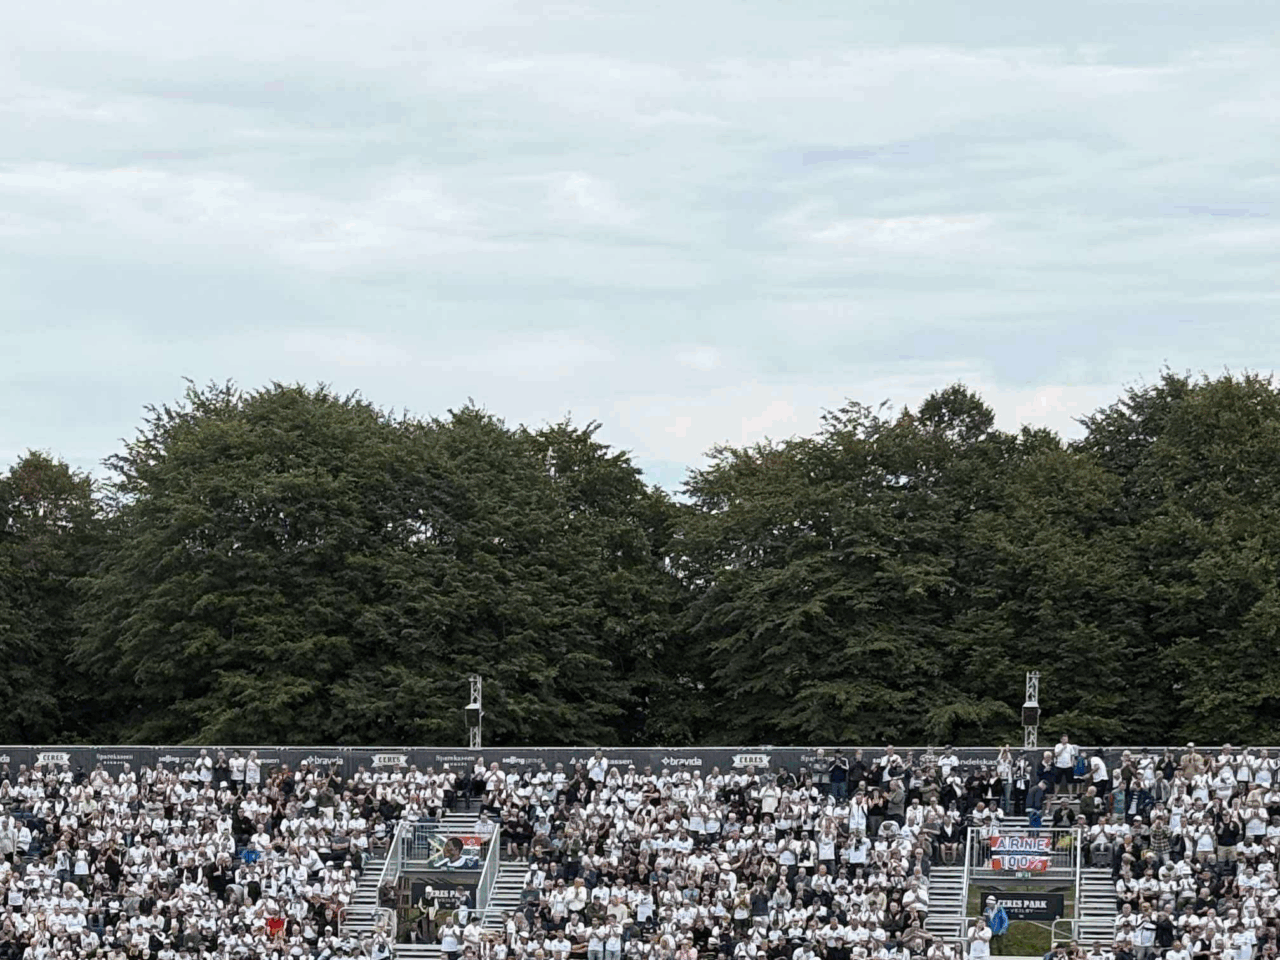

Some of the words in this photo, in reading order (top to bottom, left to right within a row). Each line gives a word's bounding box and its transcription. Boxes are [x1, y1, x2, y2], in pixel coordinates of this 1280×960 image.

[314, 756, 344, 765] bravida
[670, 756, 703, 766] bravida
[996, 836, 1049, 851] ARNE
[1000, 856, 1043, 870] 100%
[1024, 900, 1047, 908] PARK
